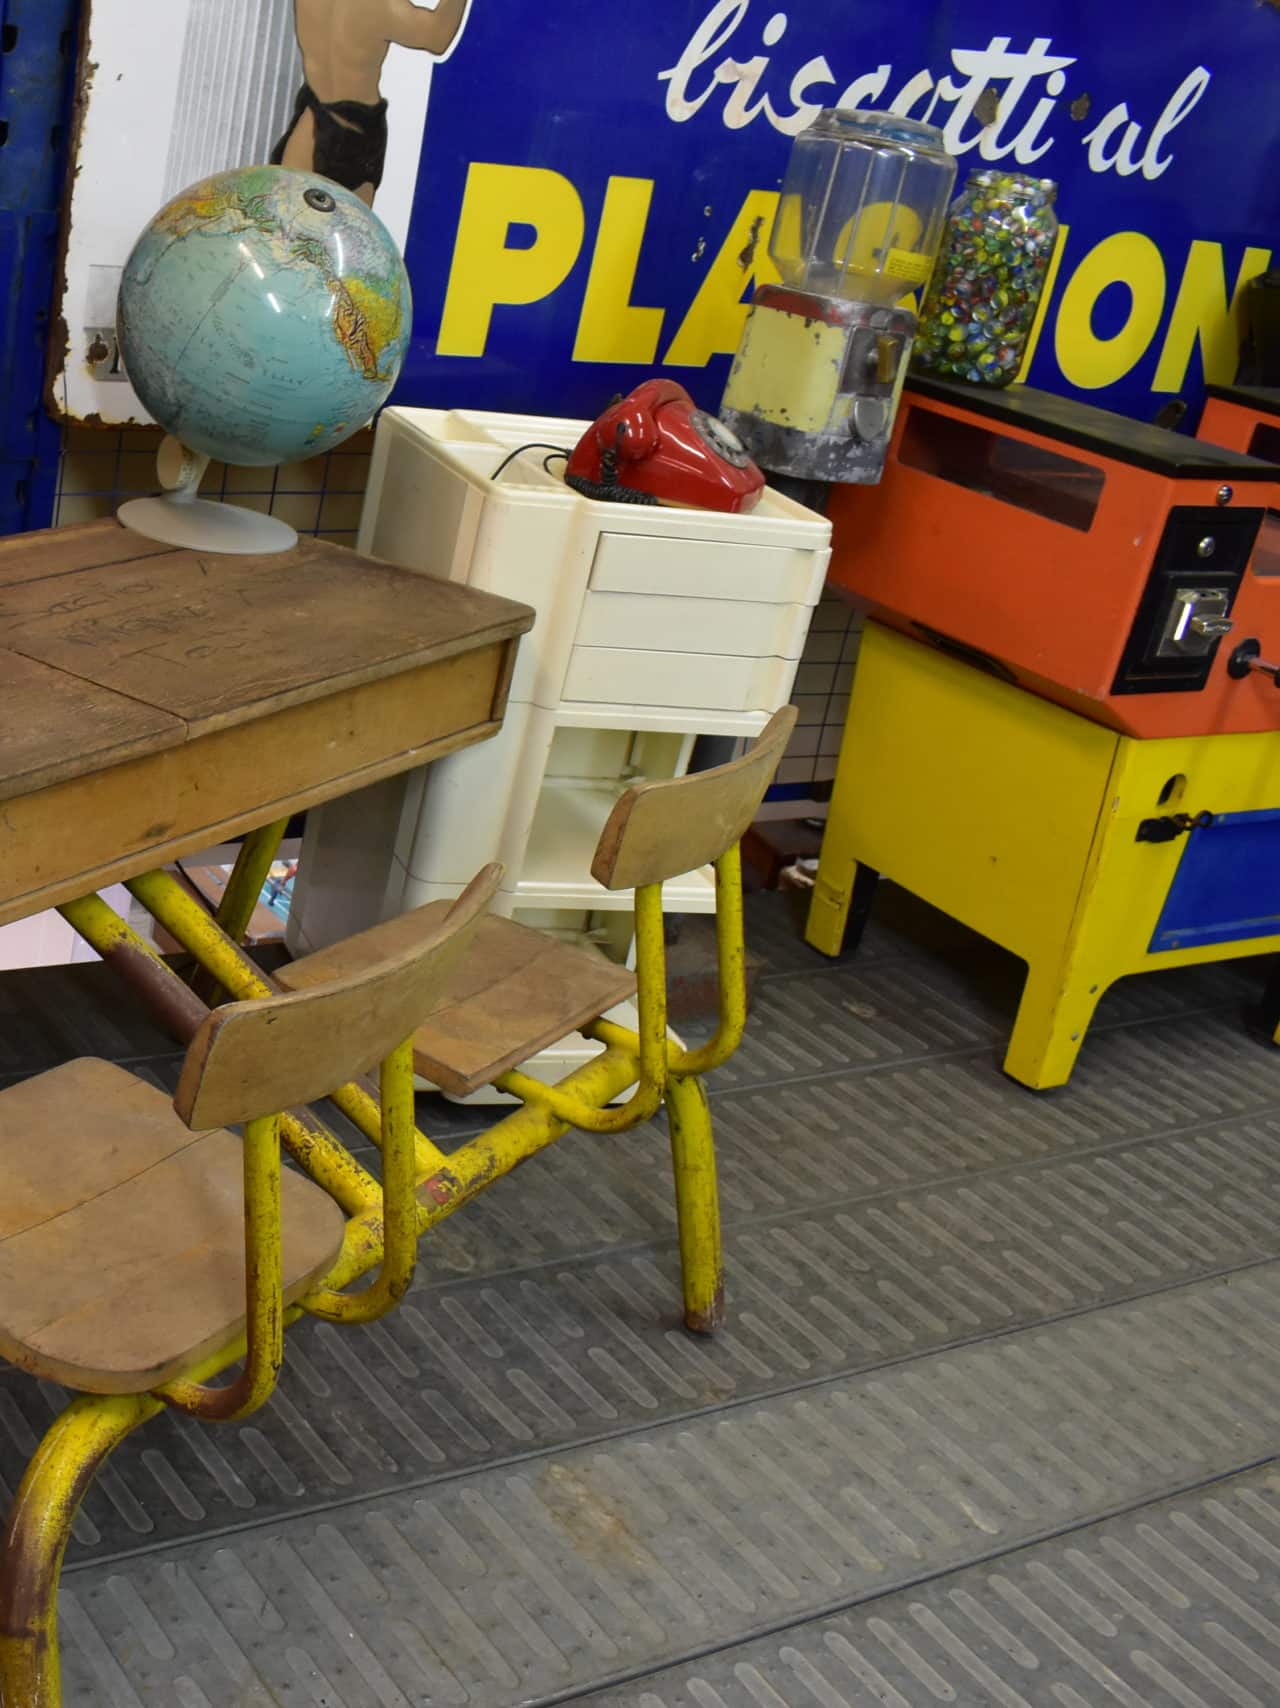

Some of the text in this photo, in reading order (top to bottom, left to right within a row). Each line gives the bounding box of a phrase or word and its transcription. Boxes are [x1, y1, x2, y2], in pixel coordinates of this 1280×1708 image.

[658, 0, 1212, 181] biscotti al
[435, 161, 1272, 394] PLASON
